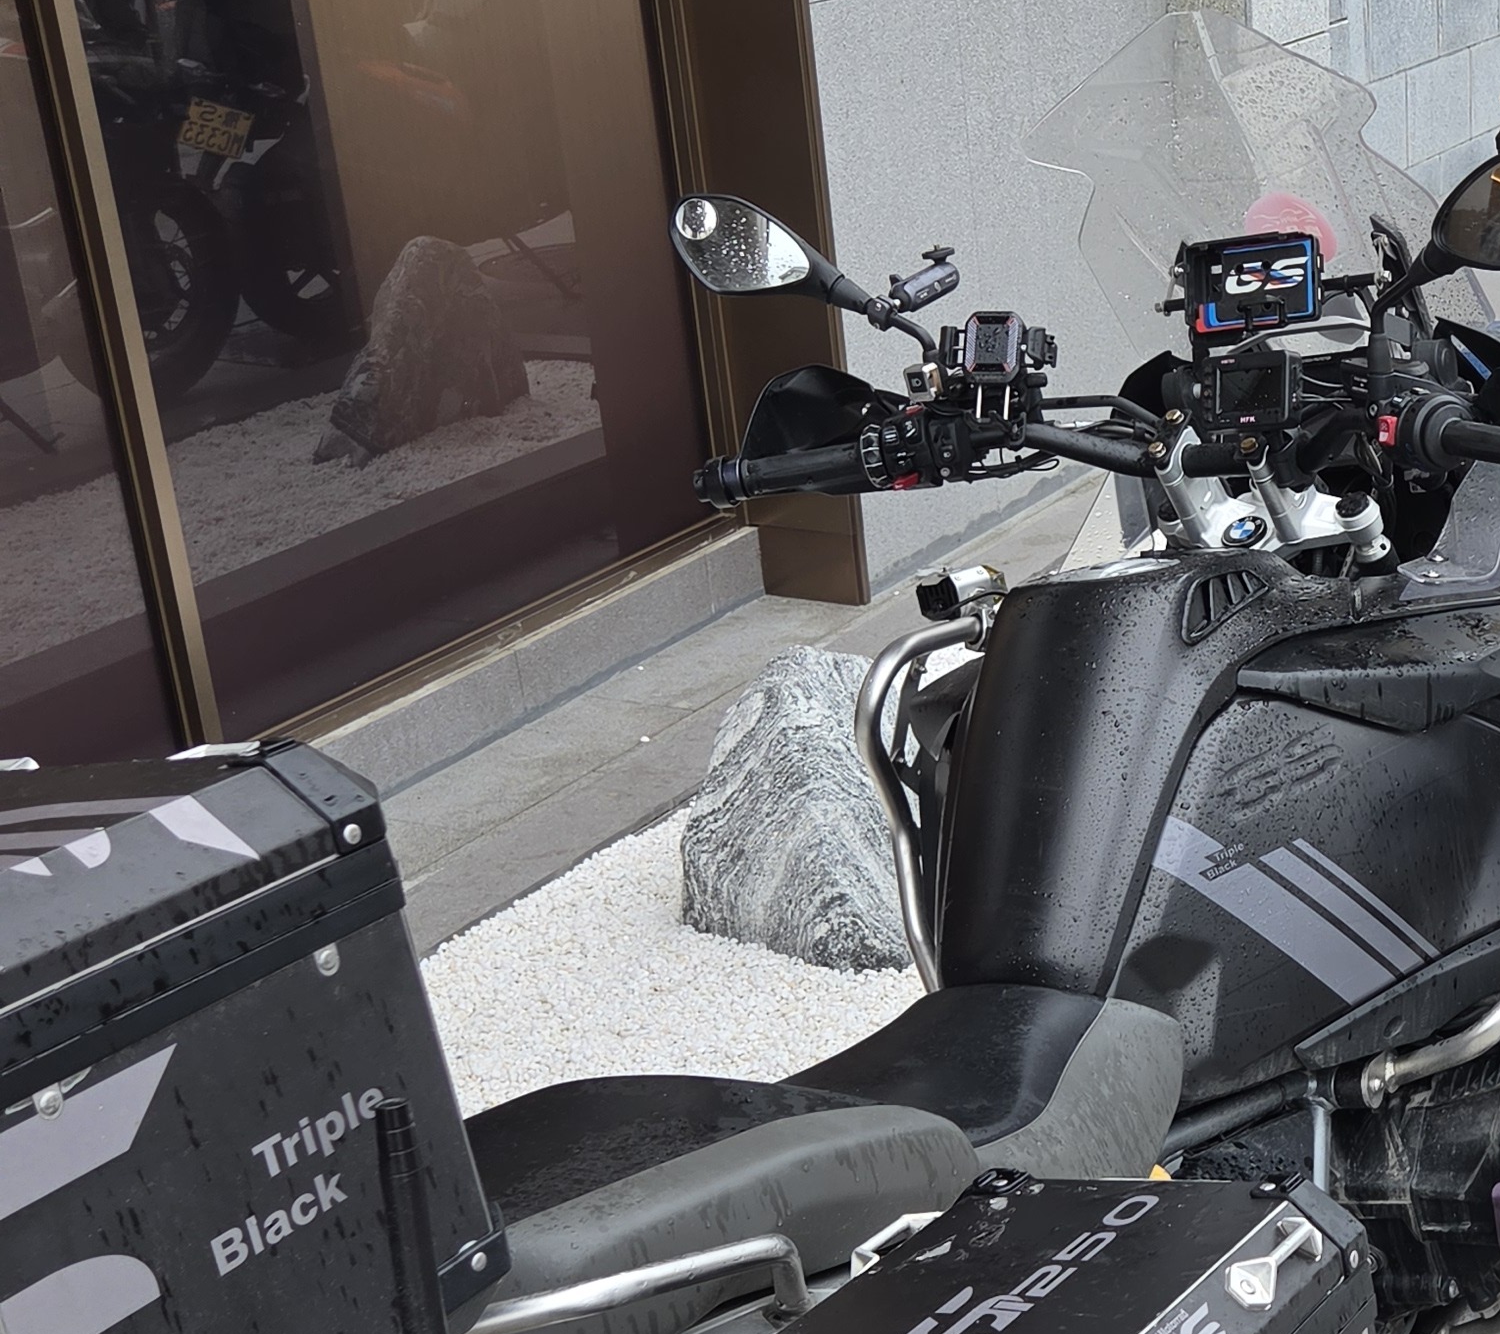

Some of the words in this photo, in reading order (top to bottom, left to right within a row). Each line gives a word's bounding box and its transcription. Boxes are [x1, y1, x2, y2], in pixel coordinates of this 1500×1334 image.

[1206, 859, 1238, 879] Black
[1213, 843, 1245, 862] Triple
[251, 1087, 384, 1178] Triple
[210, 1172, 348, 1277] Black
